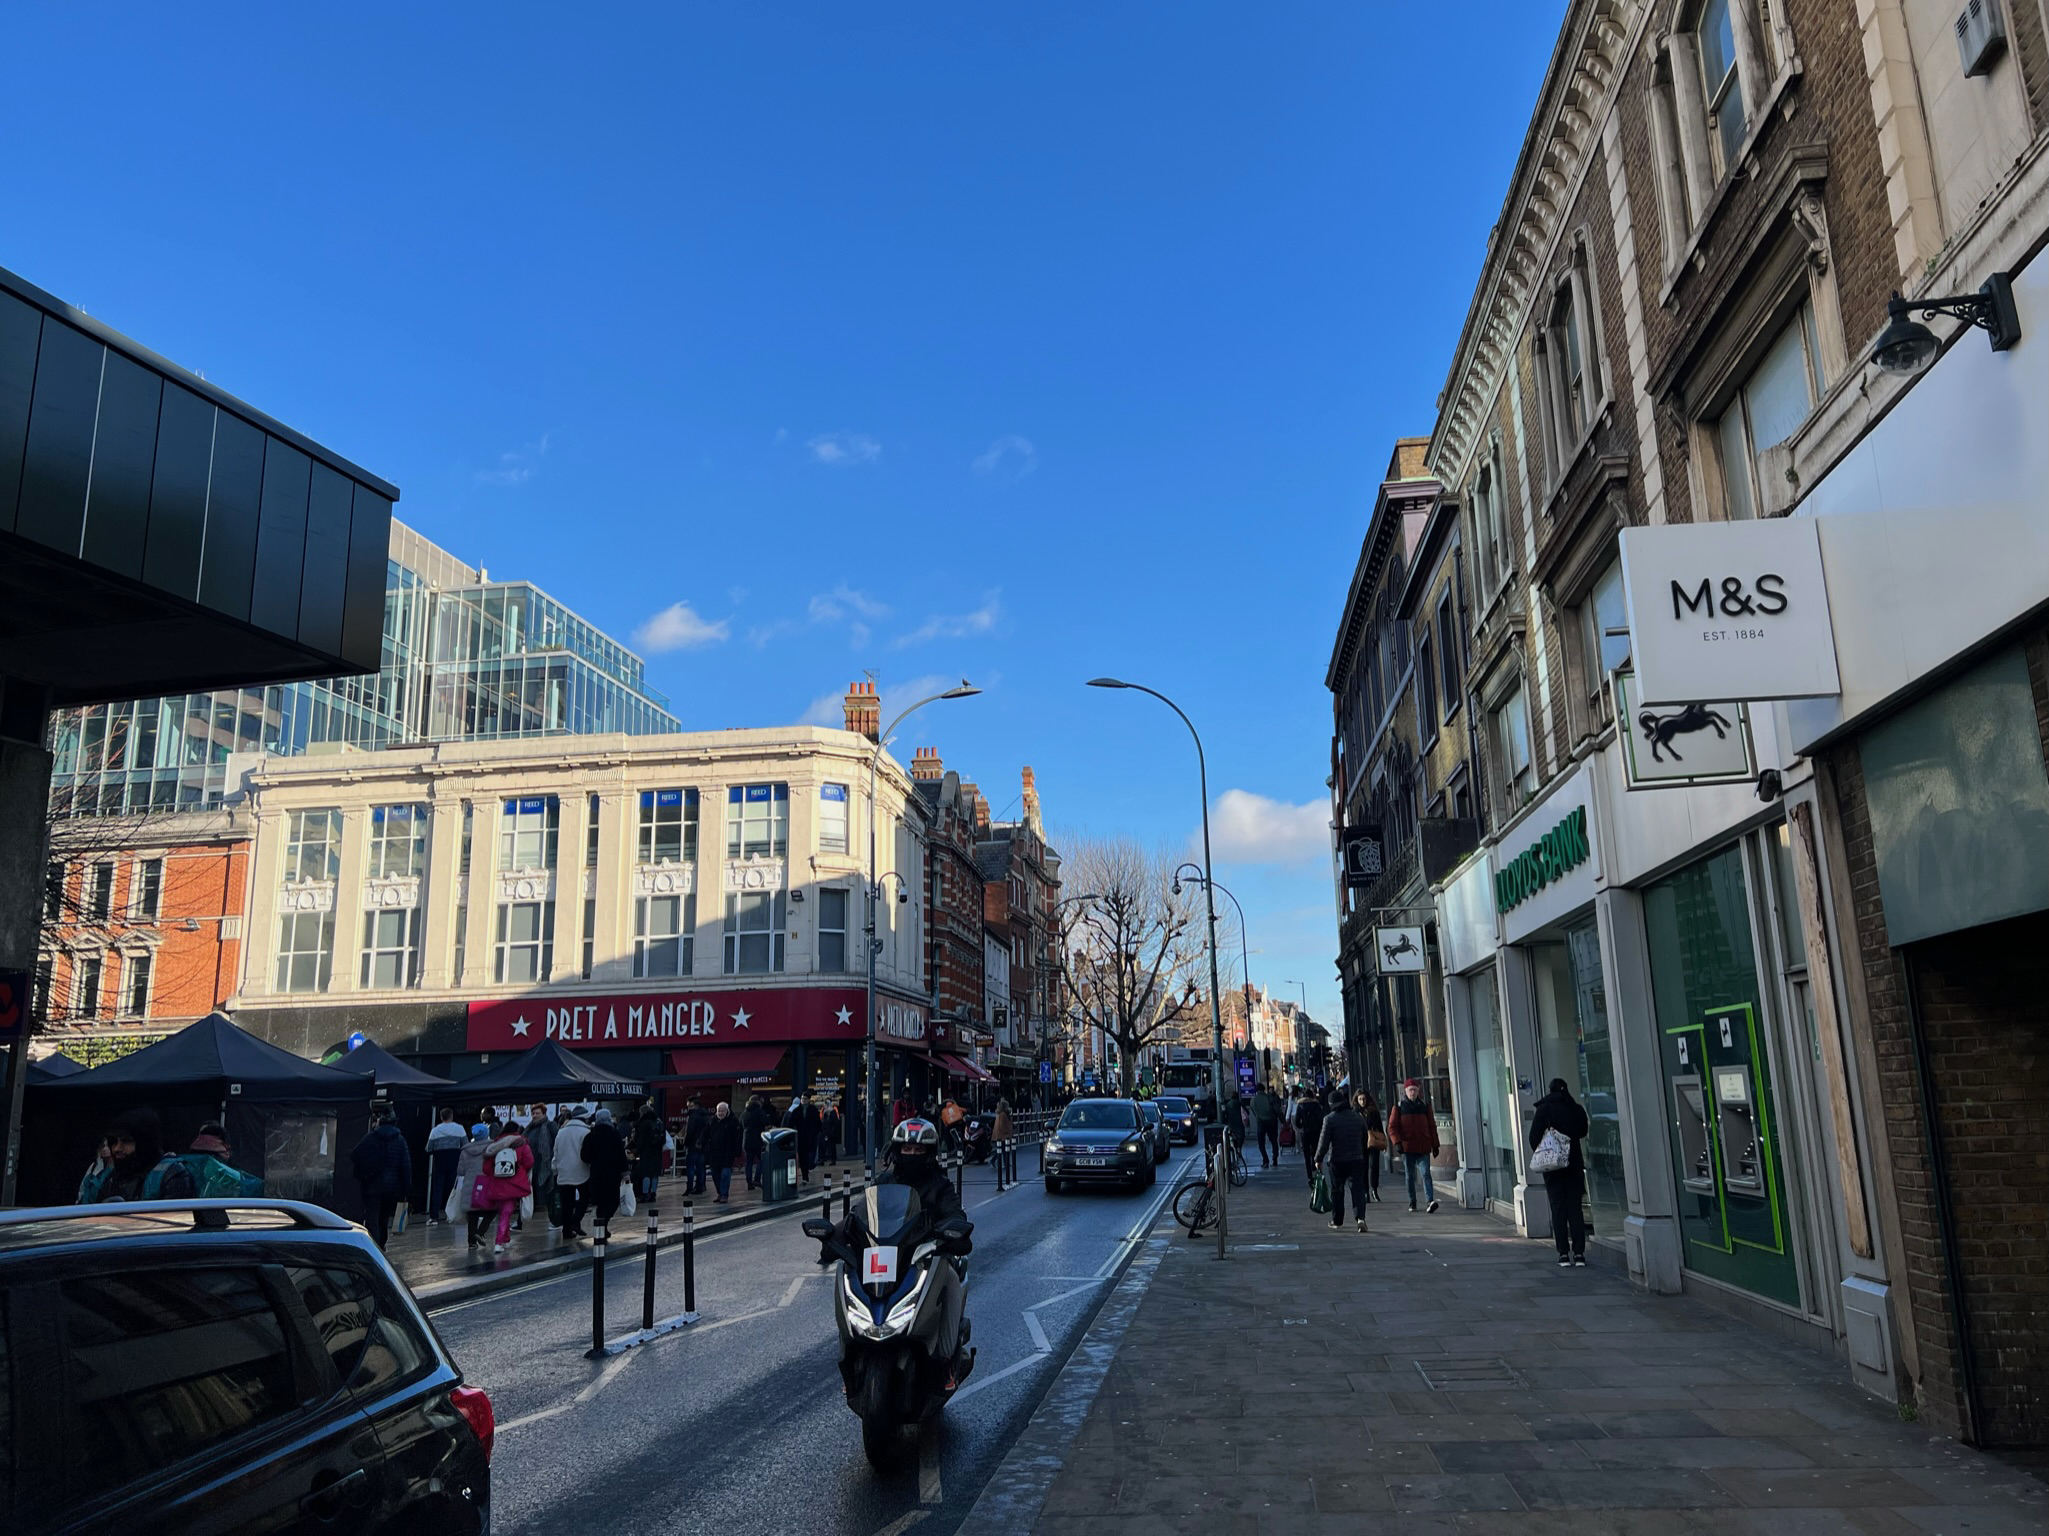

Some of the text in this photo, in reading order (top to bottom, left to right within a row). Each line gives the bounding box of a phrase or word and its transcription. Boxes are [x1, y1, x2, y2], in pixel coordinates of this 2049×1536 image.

[1671, 574, 1788, 620] M&S
[1703, 629, 1764, 641] EST. 1884
[1496, 805, 1589, 913] LLOYDS BANK
[546, 1001, 715, 1040] PRET A MANGER
[591, 1083, 643, 1095] OLIVIER'S BAKERY
[871, 1253, 888, 1273] L
